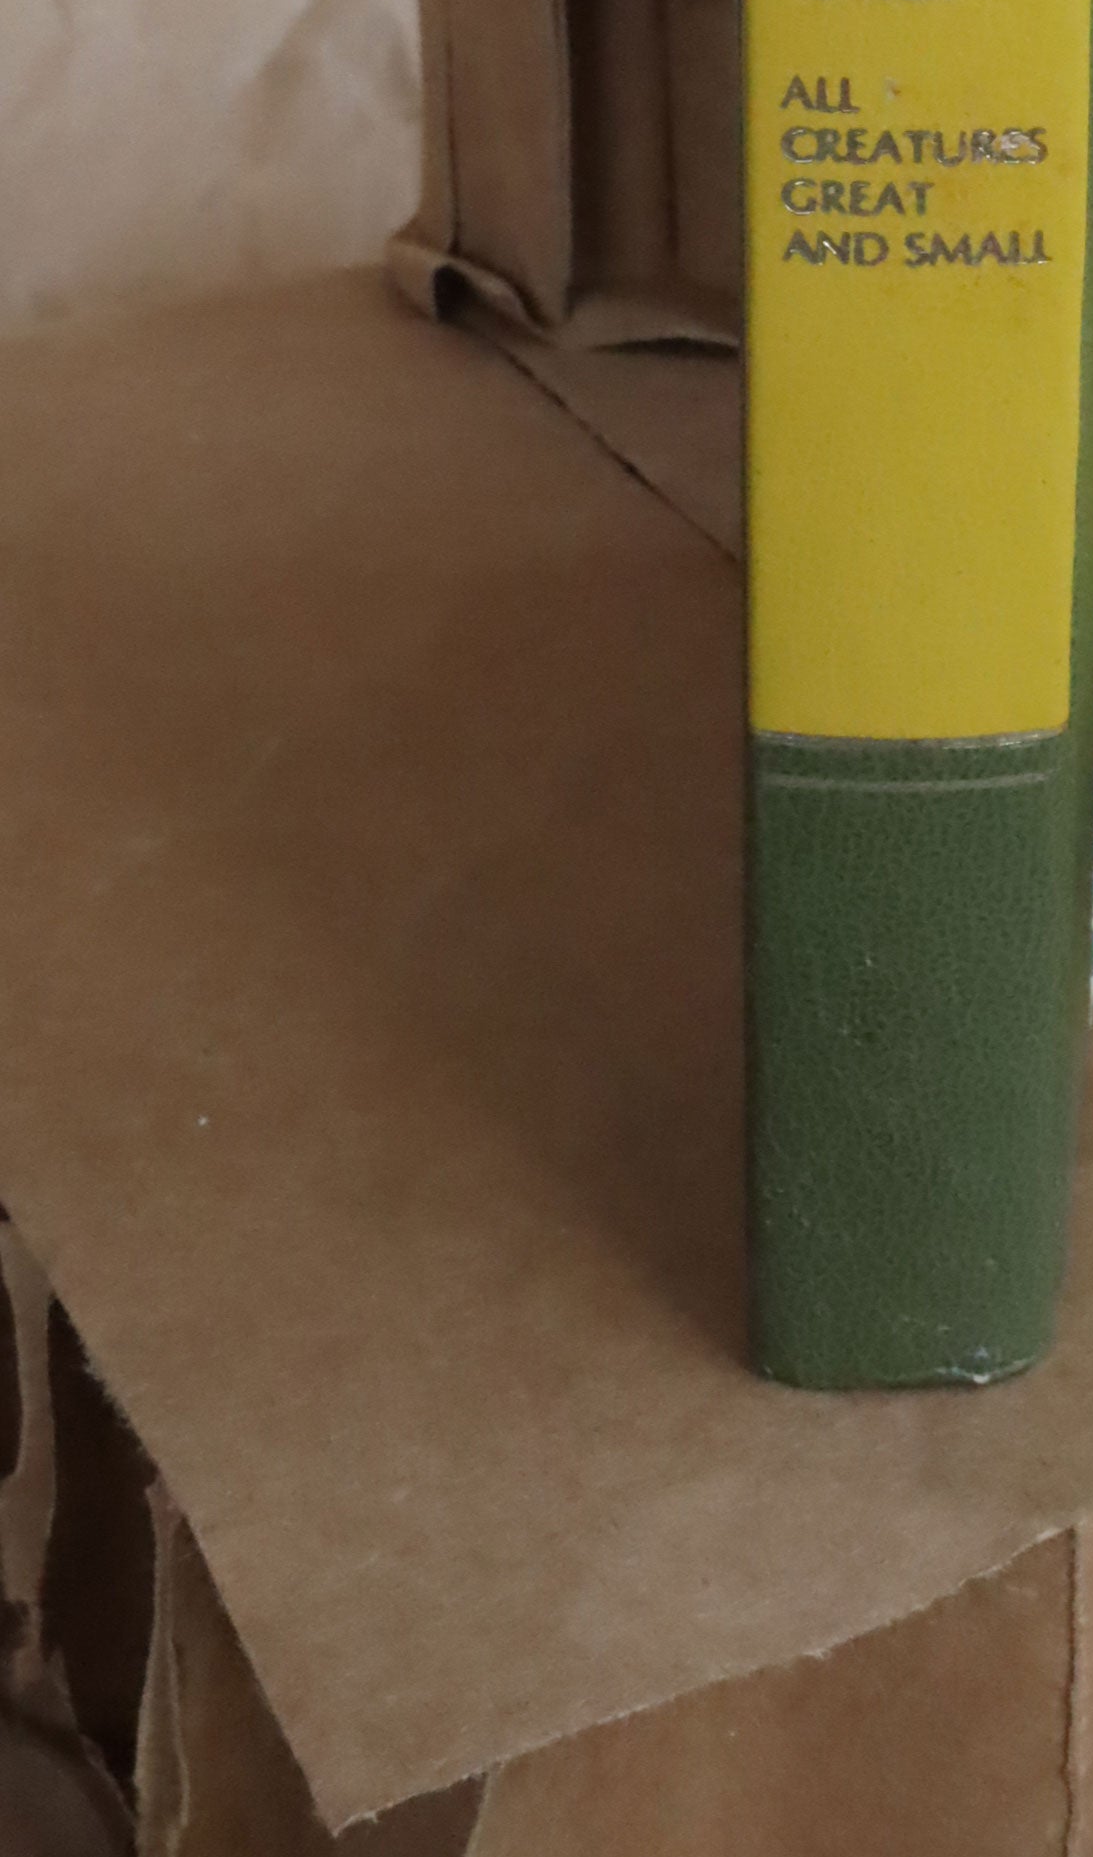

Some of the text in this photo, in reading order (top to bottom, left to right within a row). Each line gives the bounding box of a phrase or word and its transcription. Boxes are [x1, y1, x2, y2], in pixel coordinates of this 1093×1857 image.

[780, 75, 860, 114] ALL
[780, 127, 1048, 167] CREATURES
[780, 178, 935, 216] GREAT
[782, 231, 1053, 268] AND SMALL
